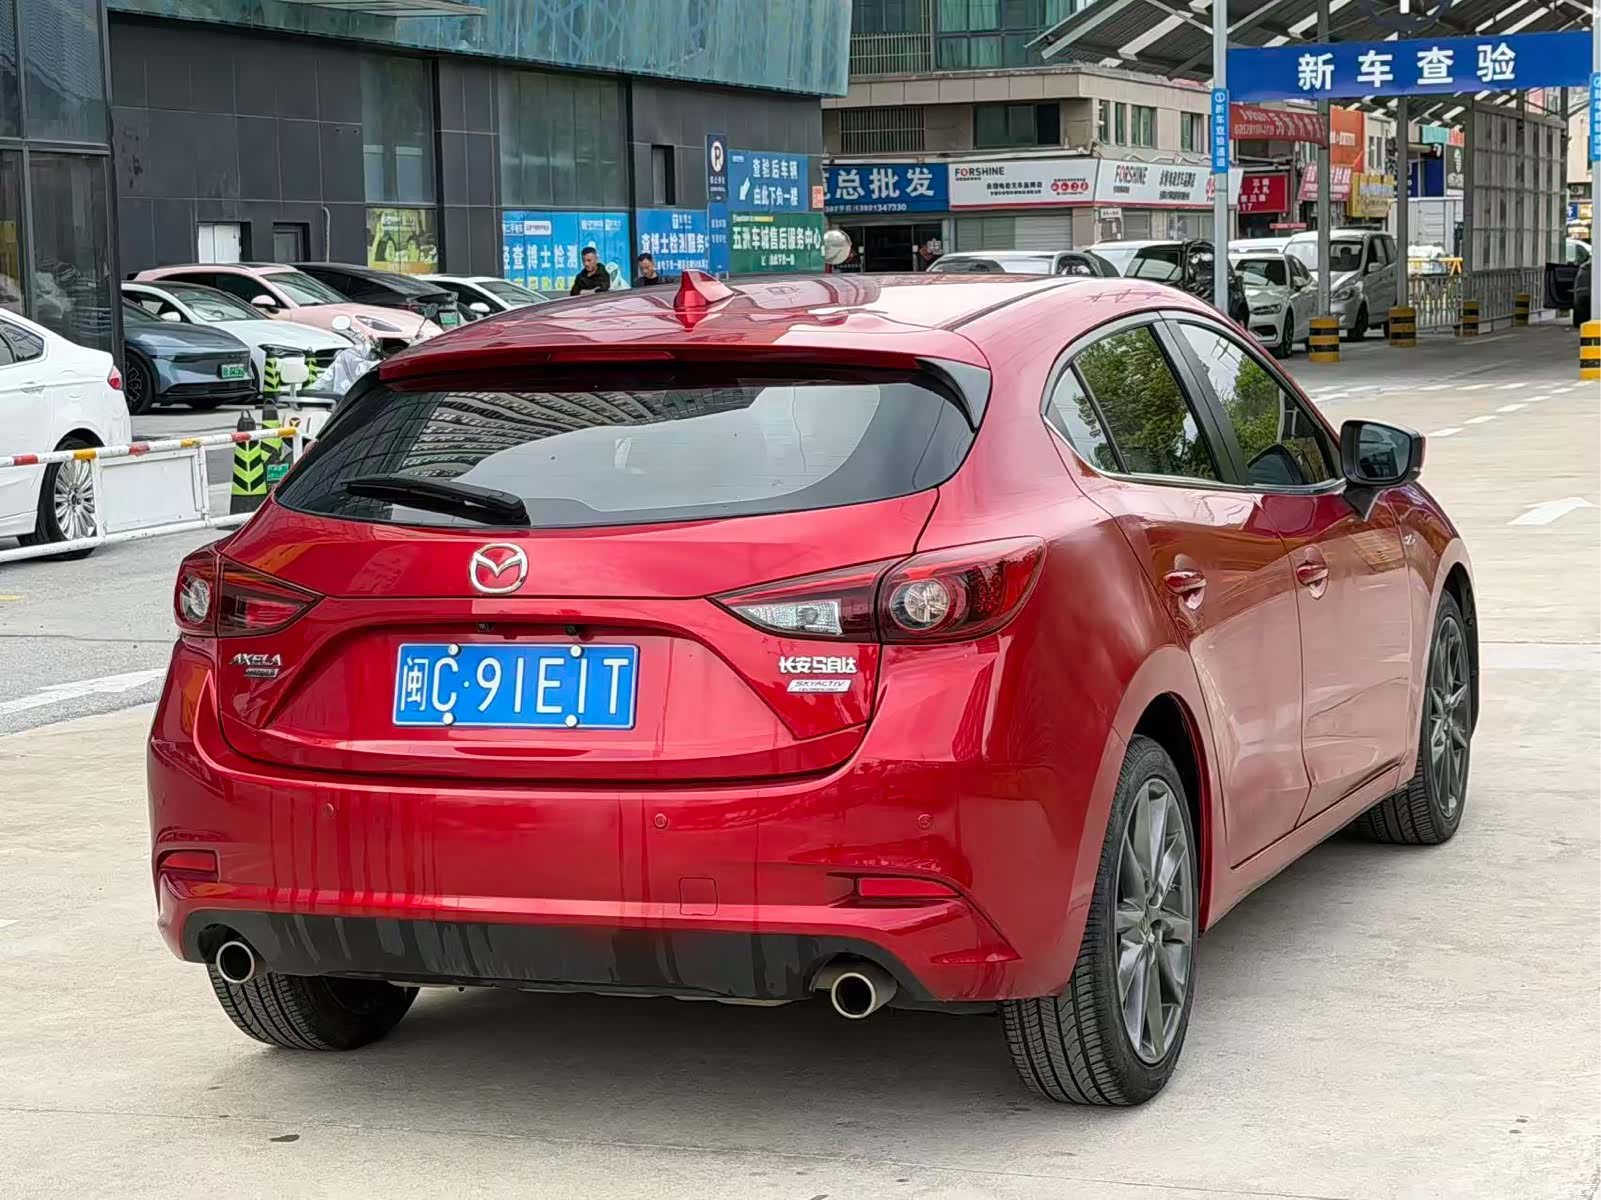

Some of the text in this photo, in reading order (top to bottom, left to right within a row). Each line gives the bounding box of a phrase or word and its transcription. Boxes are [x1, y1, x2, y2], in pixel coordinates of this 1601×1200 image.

[1298, 42, 1516, 91] 新车查验
[954, 166, 1005, 177] FORSHINE
[229, 653, 281, 666] AXELA
[778, 656, 858, 674] 长安马自达
